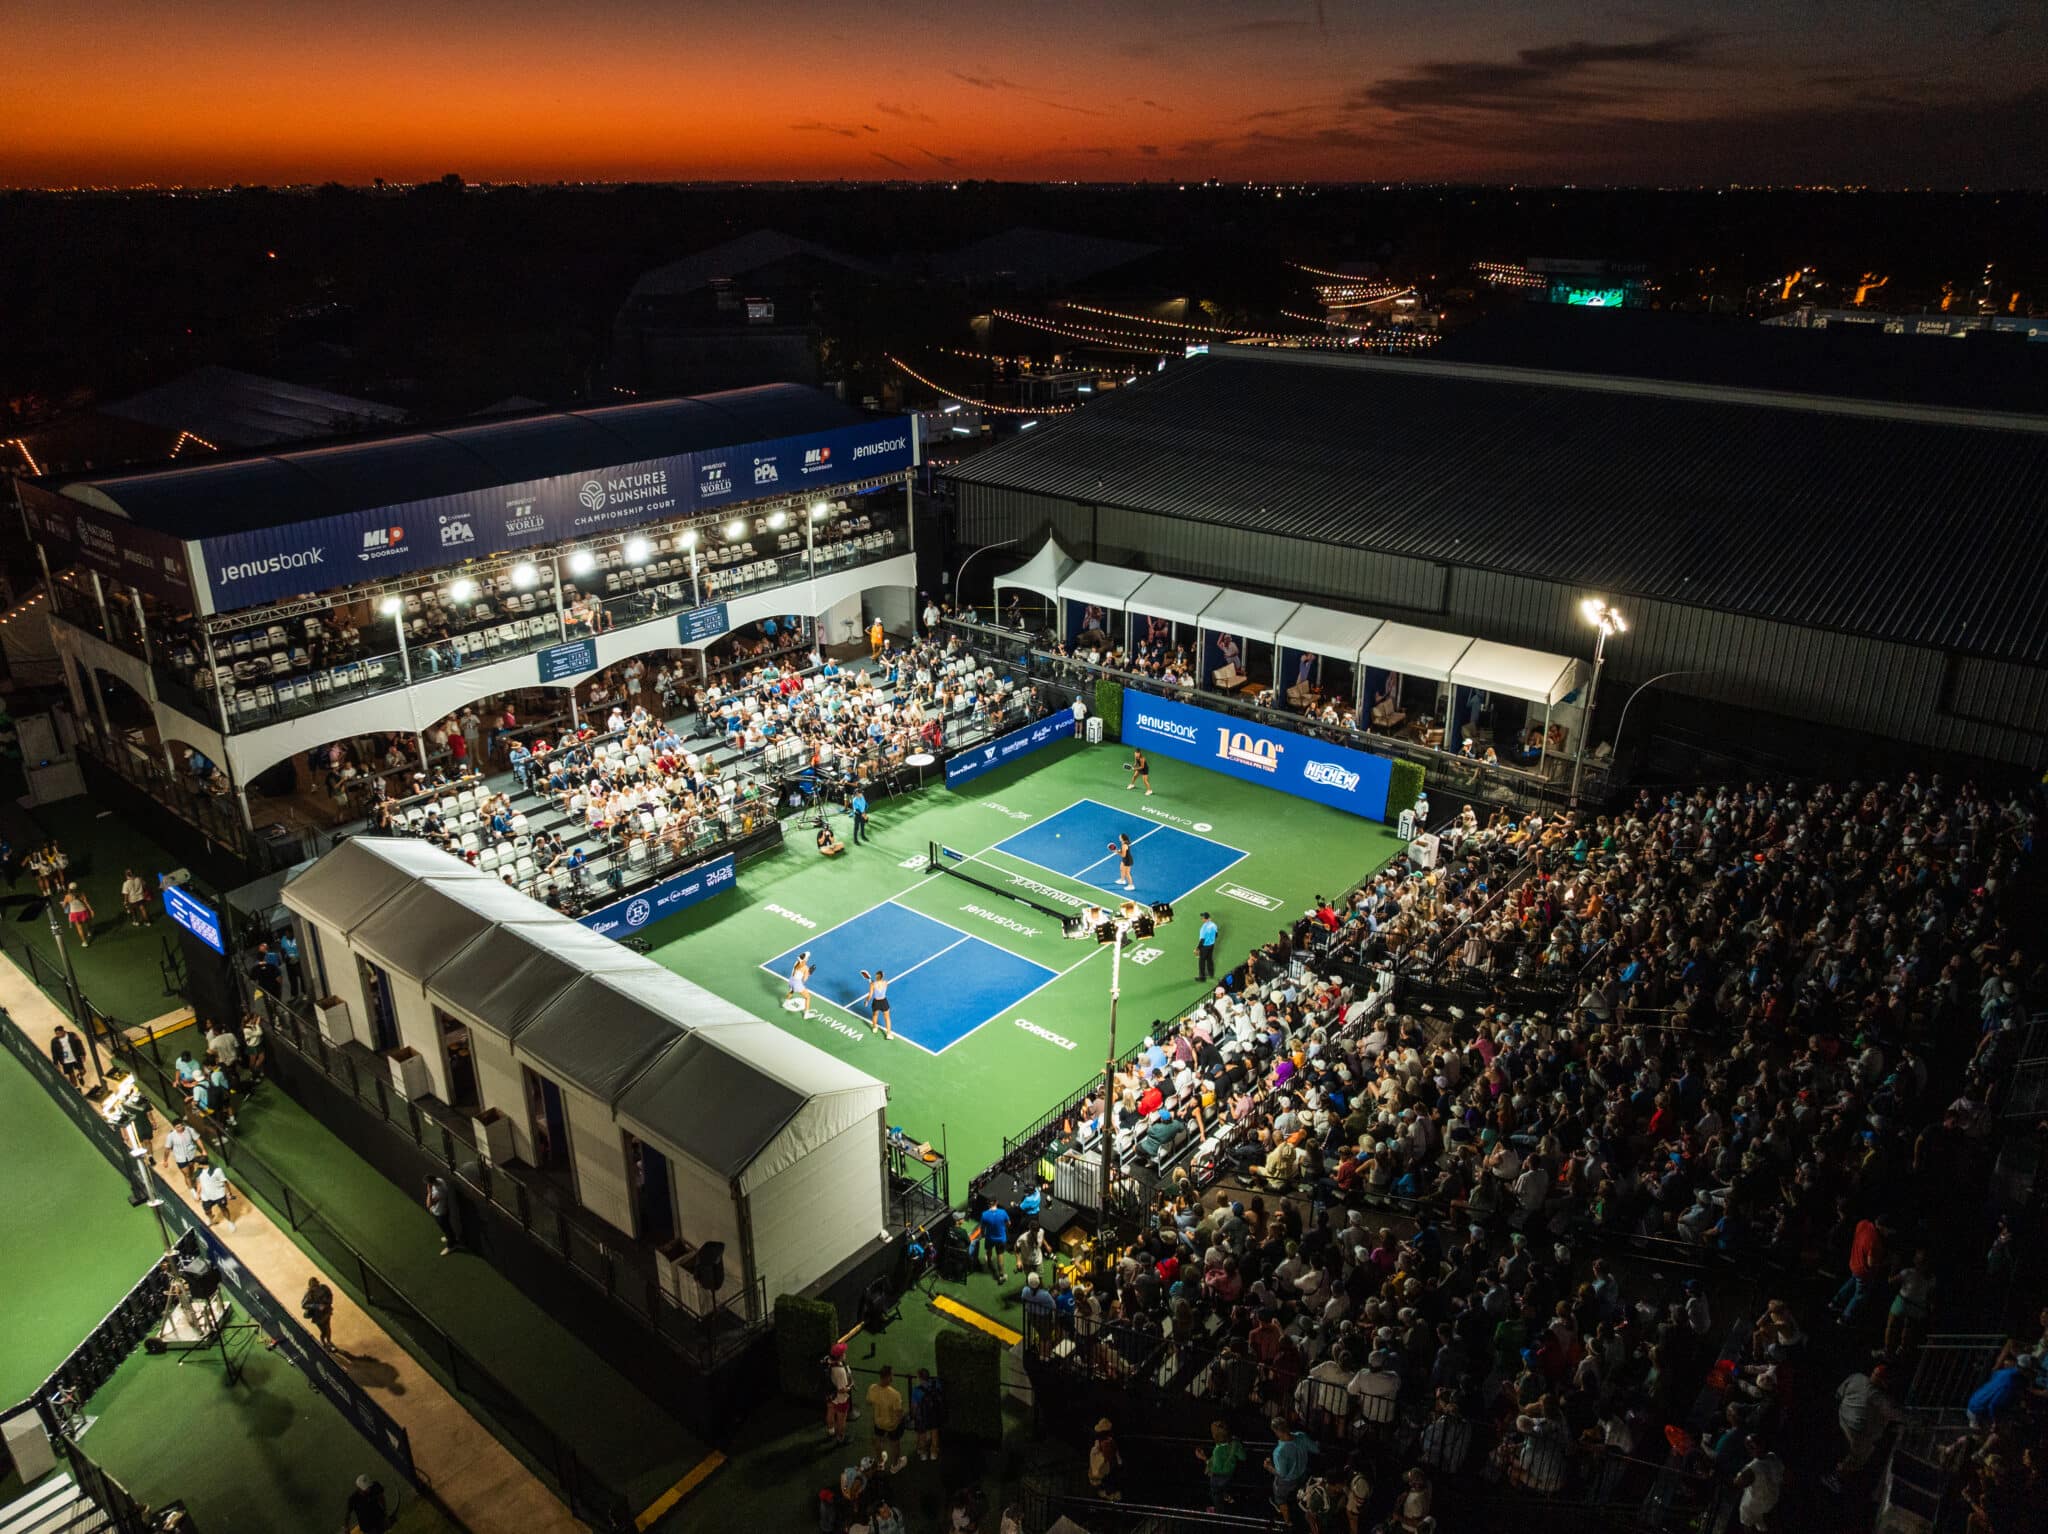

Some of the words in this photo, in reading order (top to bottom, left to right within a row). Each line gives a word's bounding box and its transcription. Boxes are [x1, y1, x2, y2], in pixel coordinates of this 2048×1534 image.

[805, 447, 831, 464] MLP
[754, 463, 778, 481] PPA
[609, 484, 668, 504] SUNSHINE
[700, 480, 732, 494] WORLD
[574, 505, 644, 526] CHAMPIONSHIP
[647, 499, 676, 511] COURT
[440, 521, 475, 544] PPA
[505, 516, 545, 533] WORLD
[363, 526, 404, 548] MLP
[370, 546, 409, 559] DOORDASH
[1304, 760, 1360, 793] HI-CHEW
[1140, 804, 1193, 826] CARVANA
[706, 872, 734, 887] WIPES
[808, 1008, 865, 1042] CARVANA
